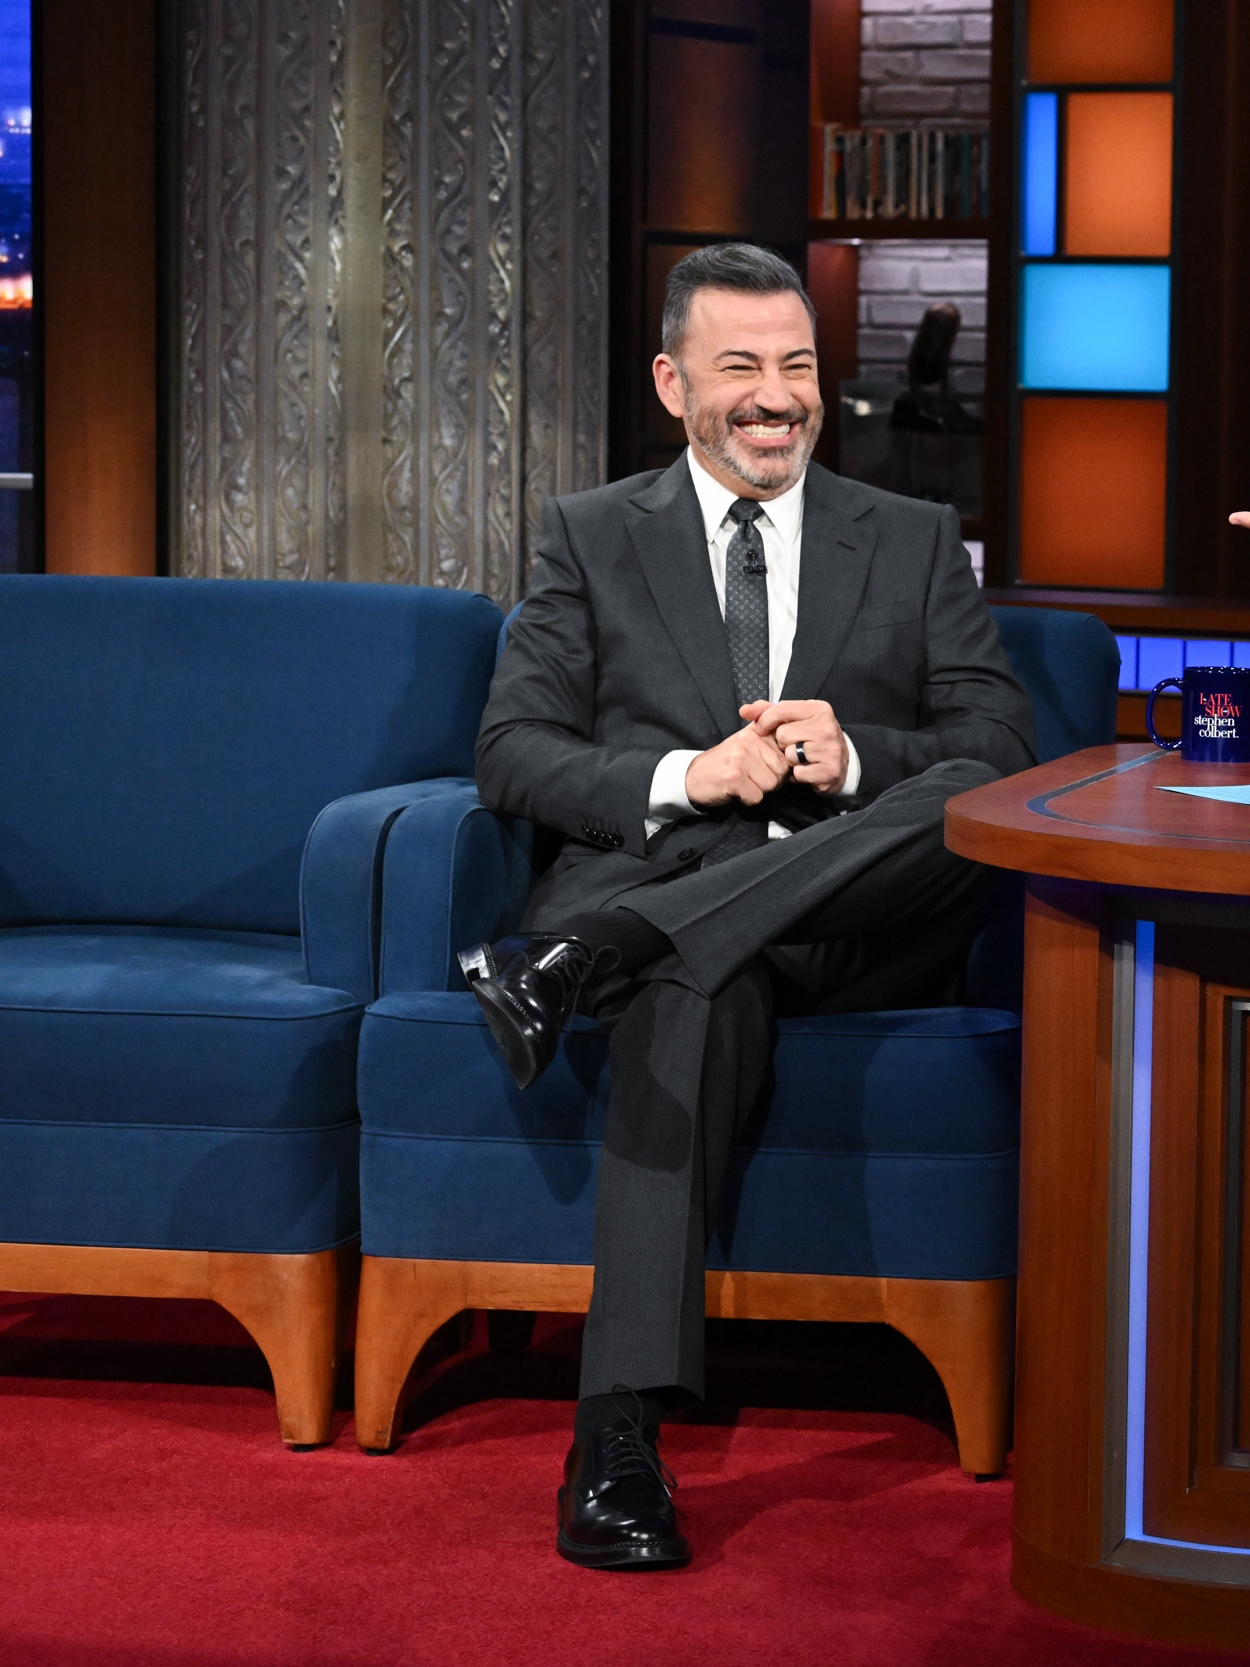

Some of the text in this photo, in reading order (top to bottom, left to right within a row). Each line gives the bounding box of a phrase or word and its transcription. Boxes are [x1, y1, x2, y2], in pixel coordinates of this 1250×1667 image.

[1199, 692, 1232, 706] LATE
[1204, 705, 1243, 717] SHOW
[1193, 713, 1236, 730] stephen
